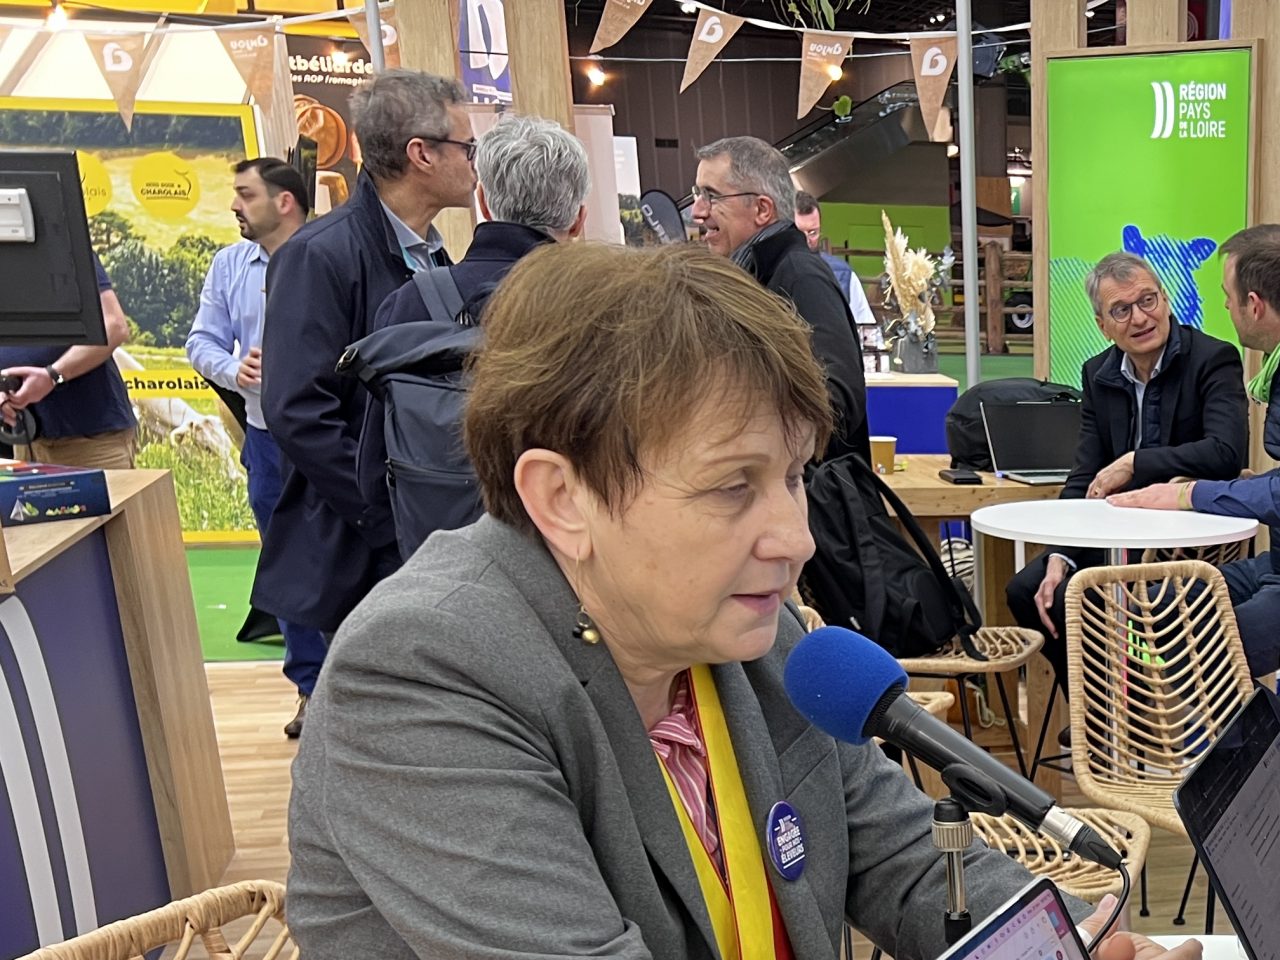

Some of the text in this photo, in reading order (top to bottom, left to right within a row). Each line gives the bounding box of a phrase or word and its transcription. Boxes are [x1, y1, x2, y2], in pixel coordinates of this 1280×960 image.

[1179, 81, 1226, 100] RÉGION
[1179, 102, 1211, 119] PAYS
[1190, 121, 1226, 138] LOIRE
[125, 376, 209, 390] charolais
